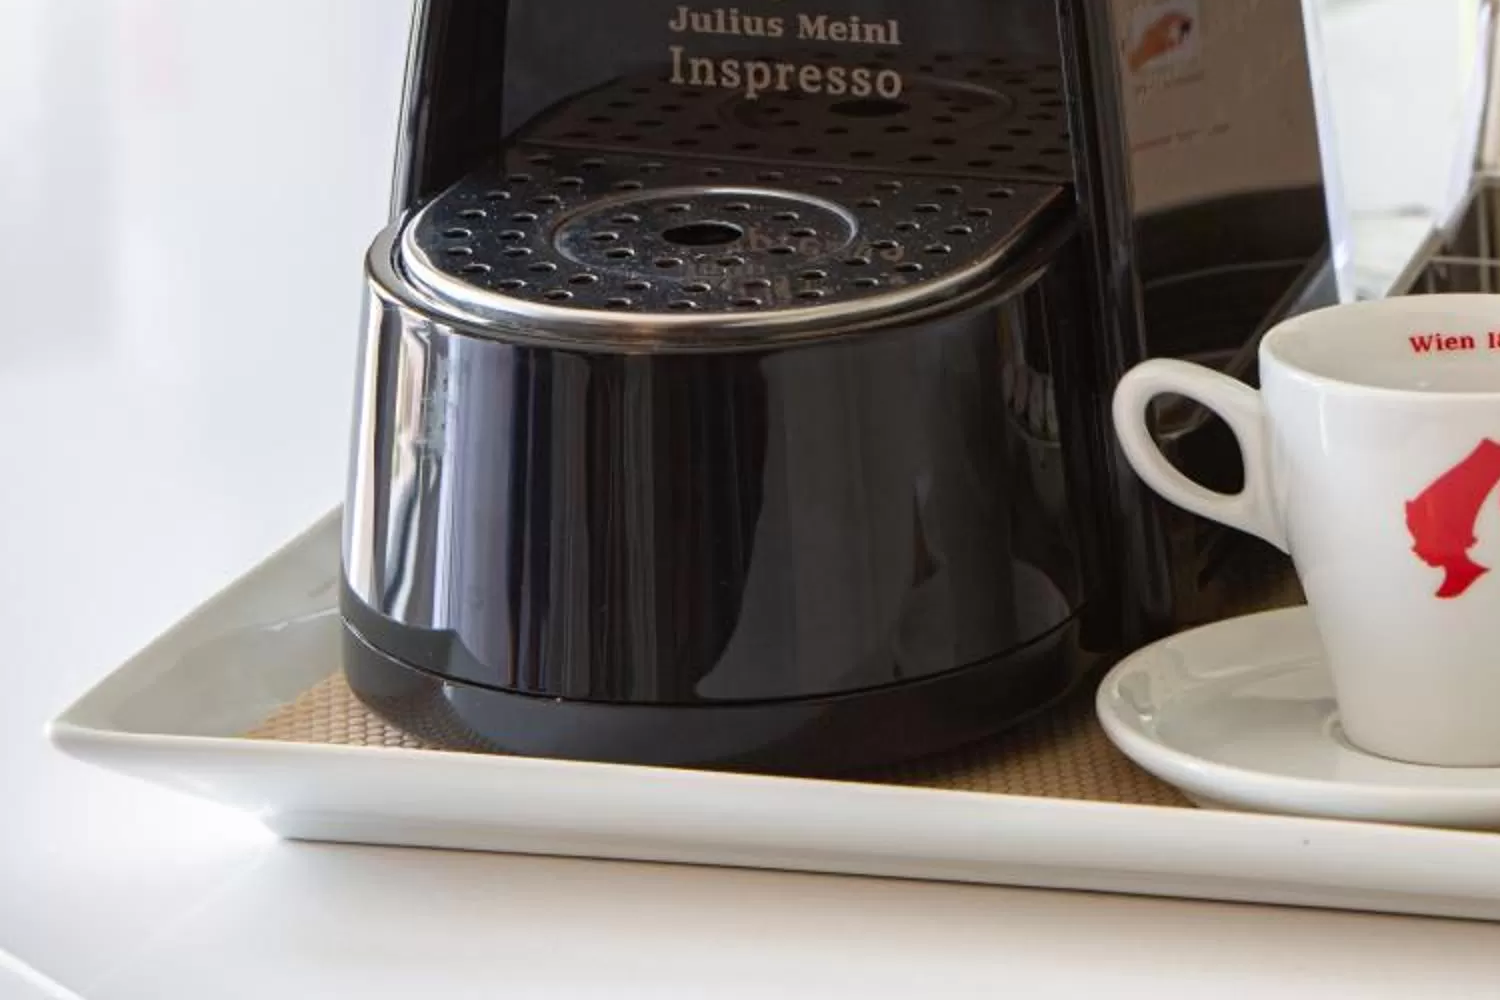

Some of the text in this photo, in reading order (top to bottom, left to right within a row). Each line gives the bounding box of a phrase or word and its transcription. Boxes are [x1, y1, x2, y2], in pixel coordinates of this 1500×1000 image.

[668, 5, 902, 45] Julius Meinl
[668, 46, 903, 99] Inspresso
[1408, 333, 1476, 354] Wien
